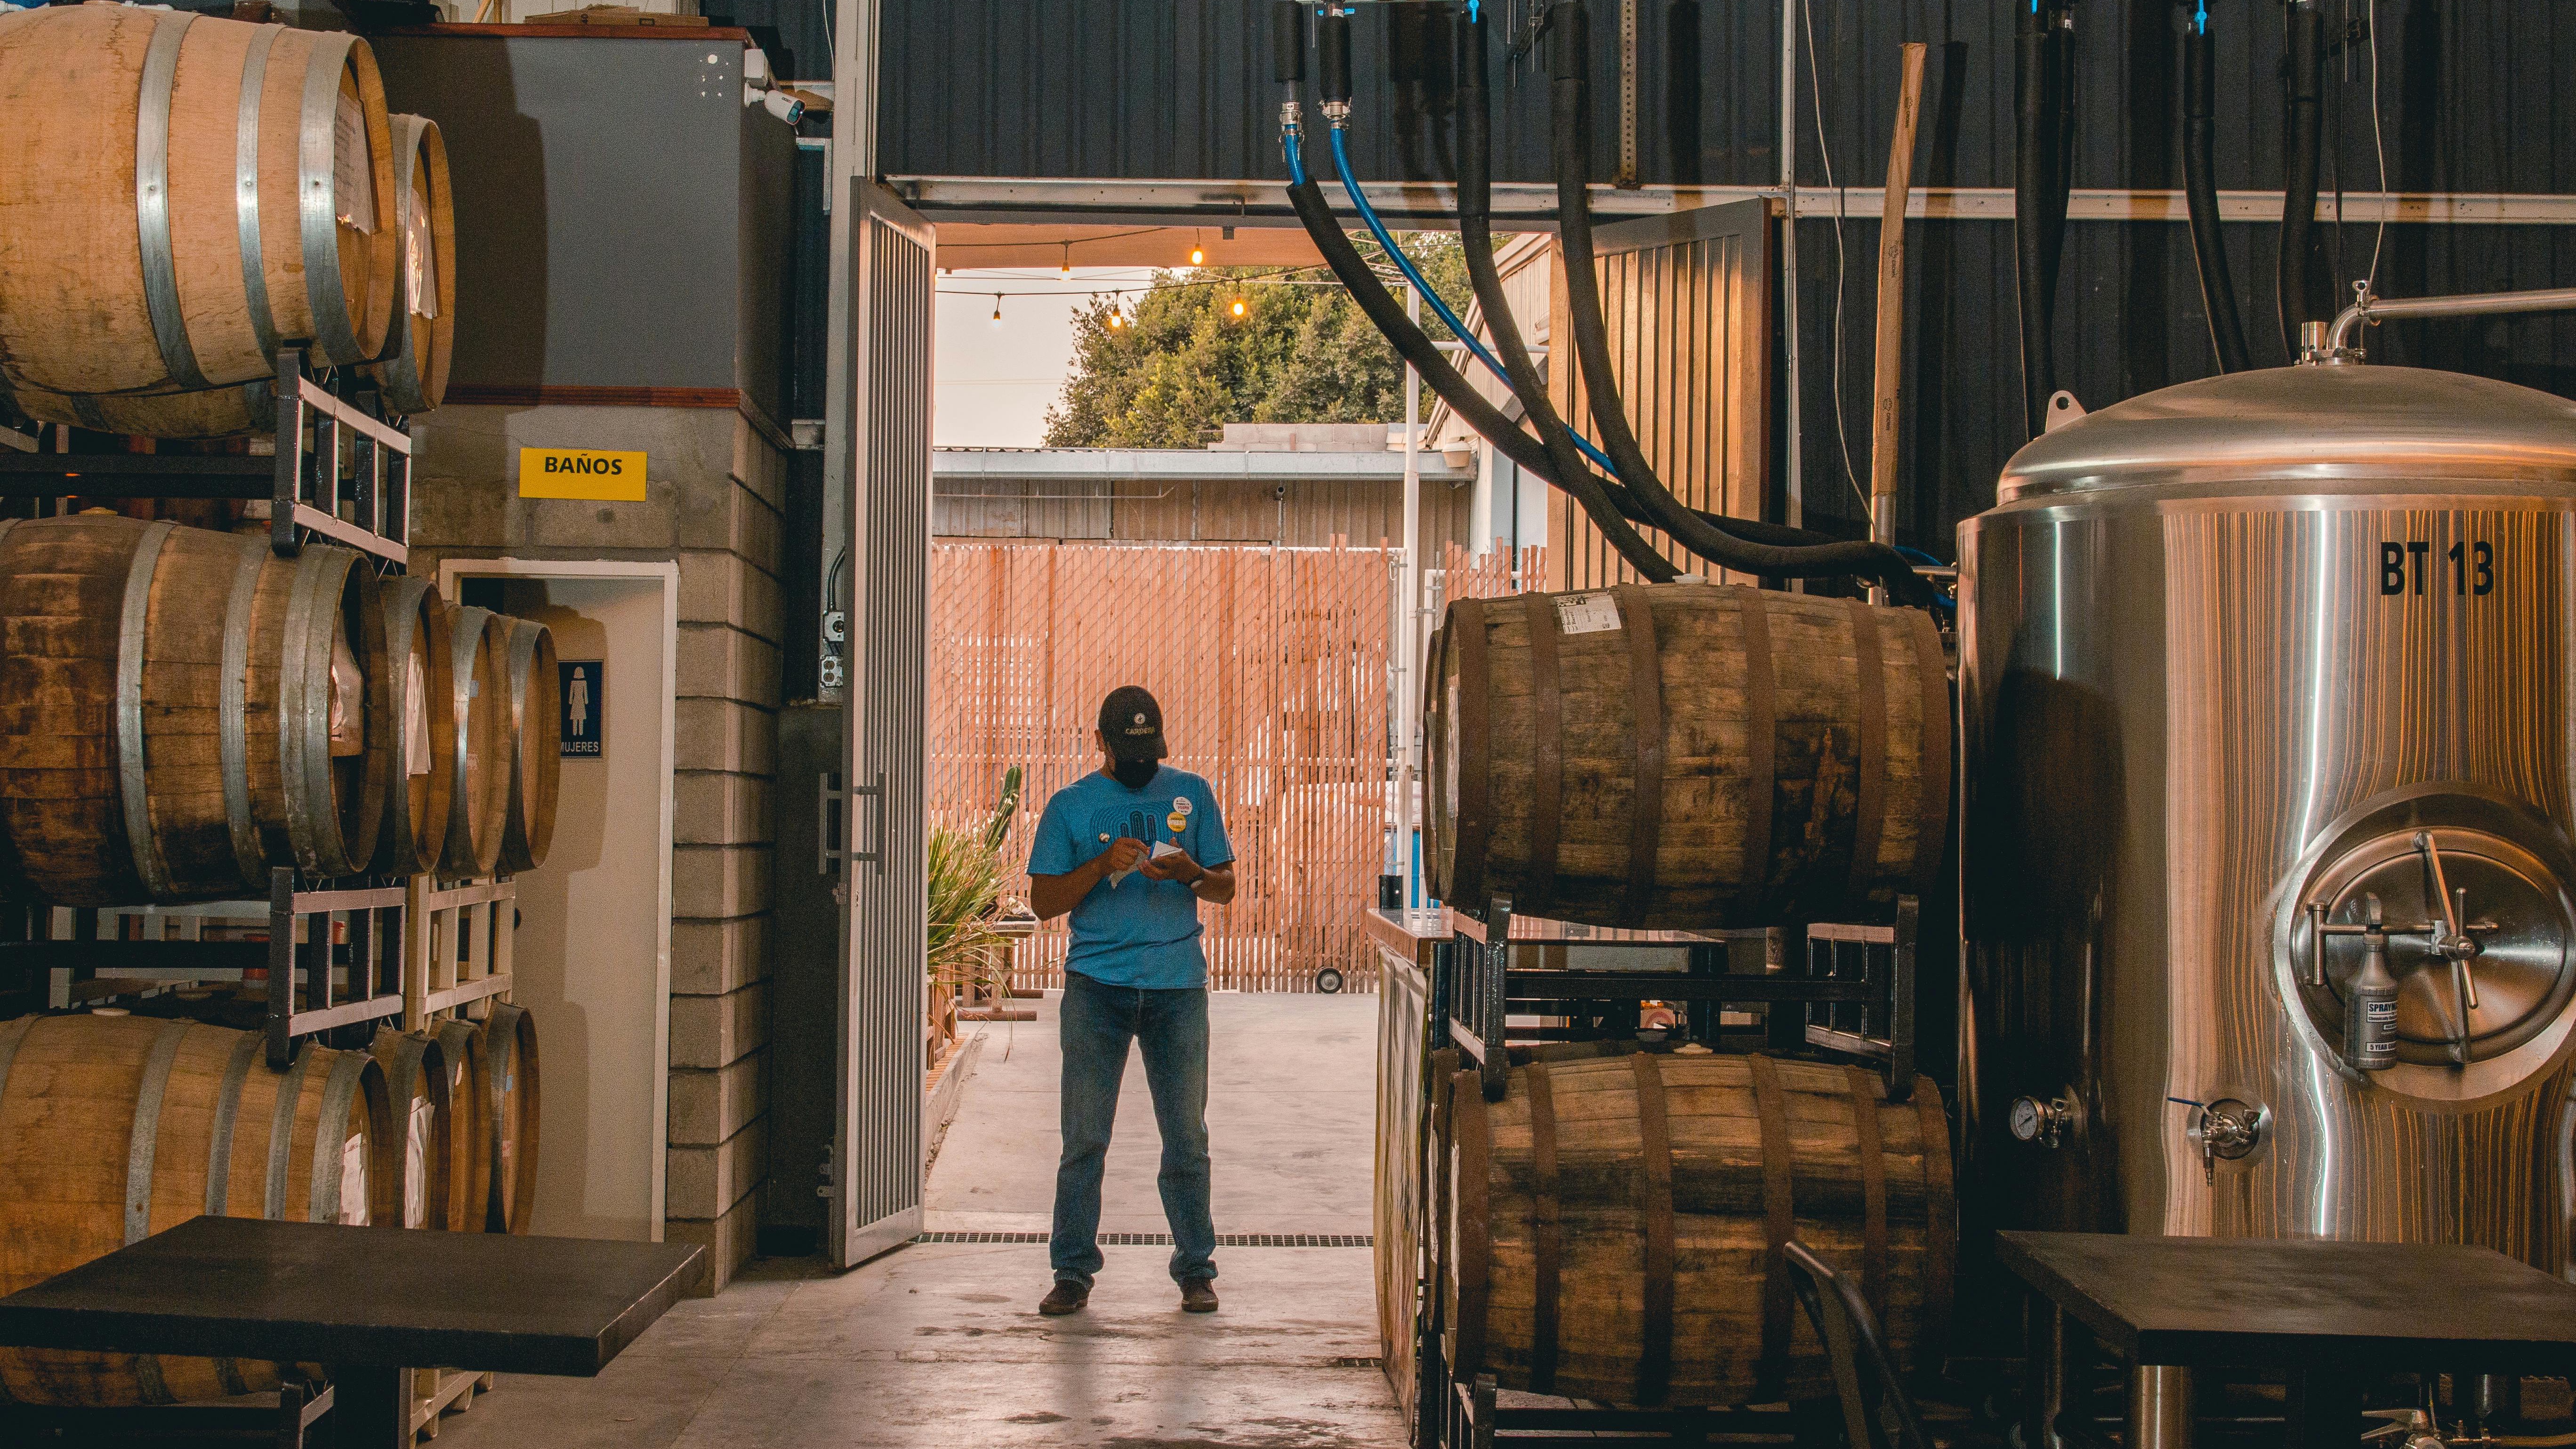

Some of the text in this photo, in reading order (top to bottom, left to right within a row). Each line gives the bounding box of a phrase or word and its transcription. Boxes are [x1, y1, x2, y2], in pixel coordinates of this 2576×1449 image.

[545, 453, 622, 475] BAÑOS
[2381, 541, 2494, 596] BT 13
